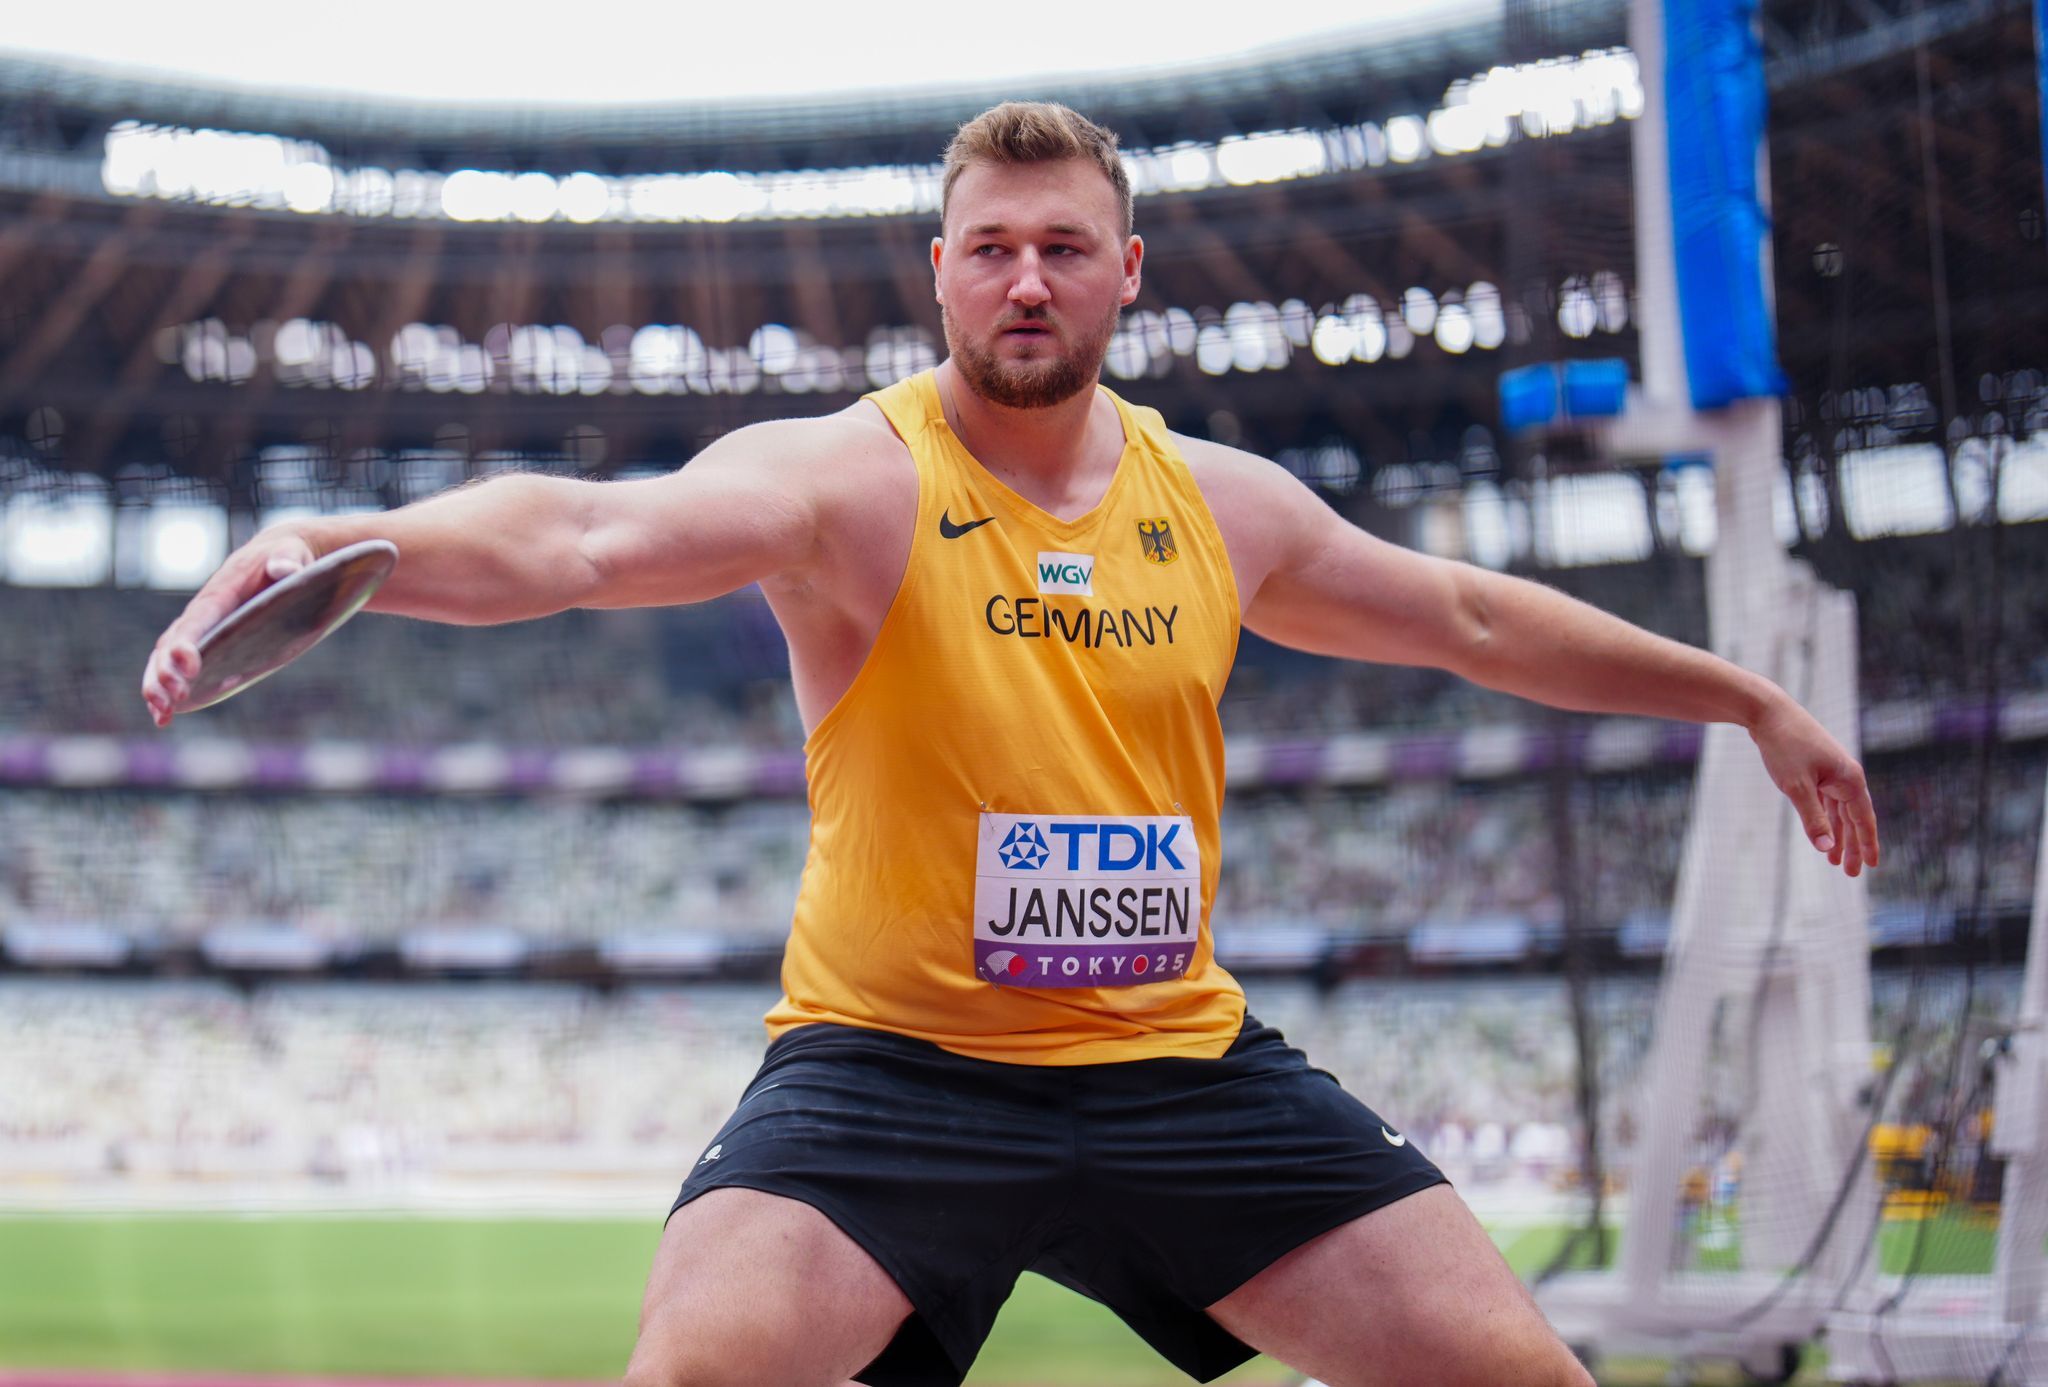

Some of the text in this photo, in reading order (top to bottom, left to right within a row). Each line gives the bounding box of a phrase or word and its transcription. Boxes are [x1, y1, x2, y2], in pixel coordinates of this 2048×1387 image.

[1039, 563, 1092, 585] WGV
[1050, 823, 1186, 871] TDK
[988, 886, 1190, 938] JANSSEN
